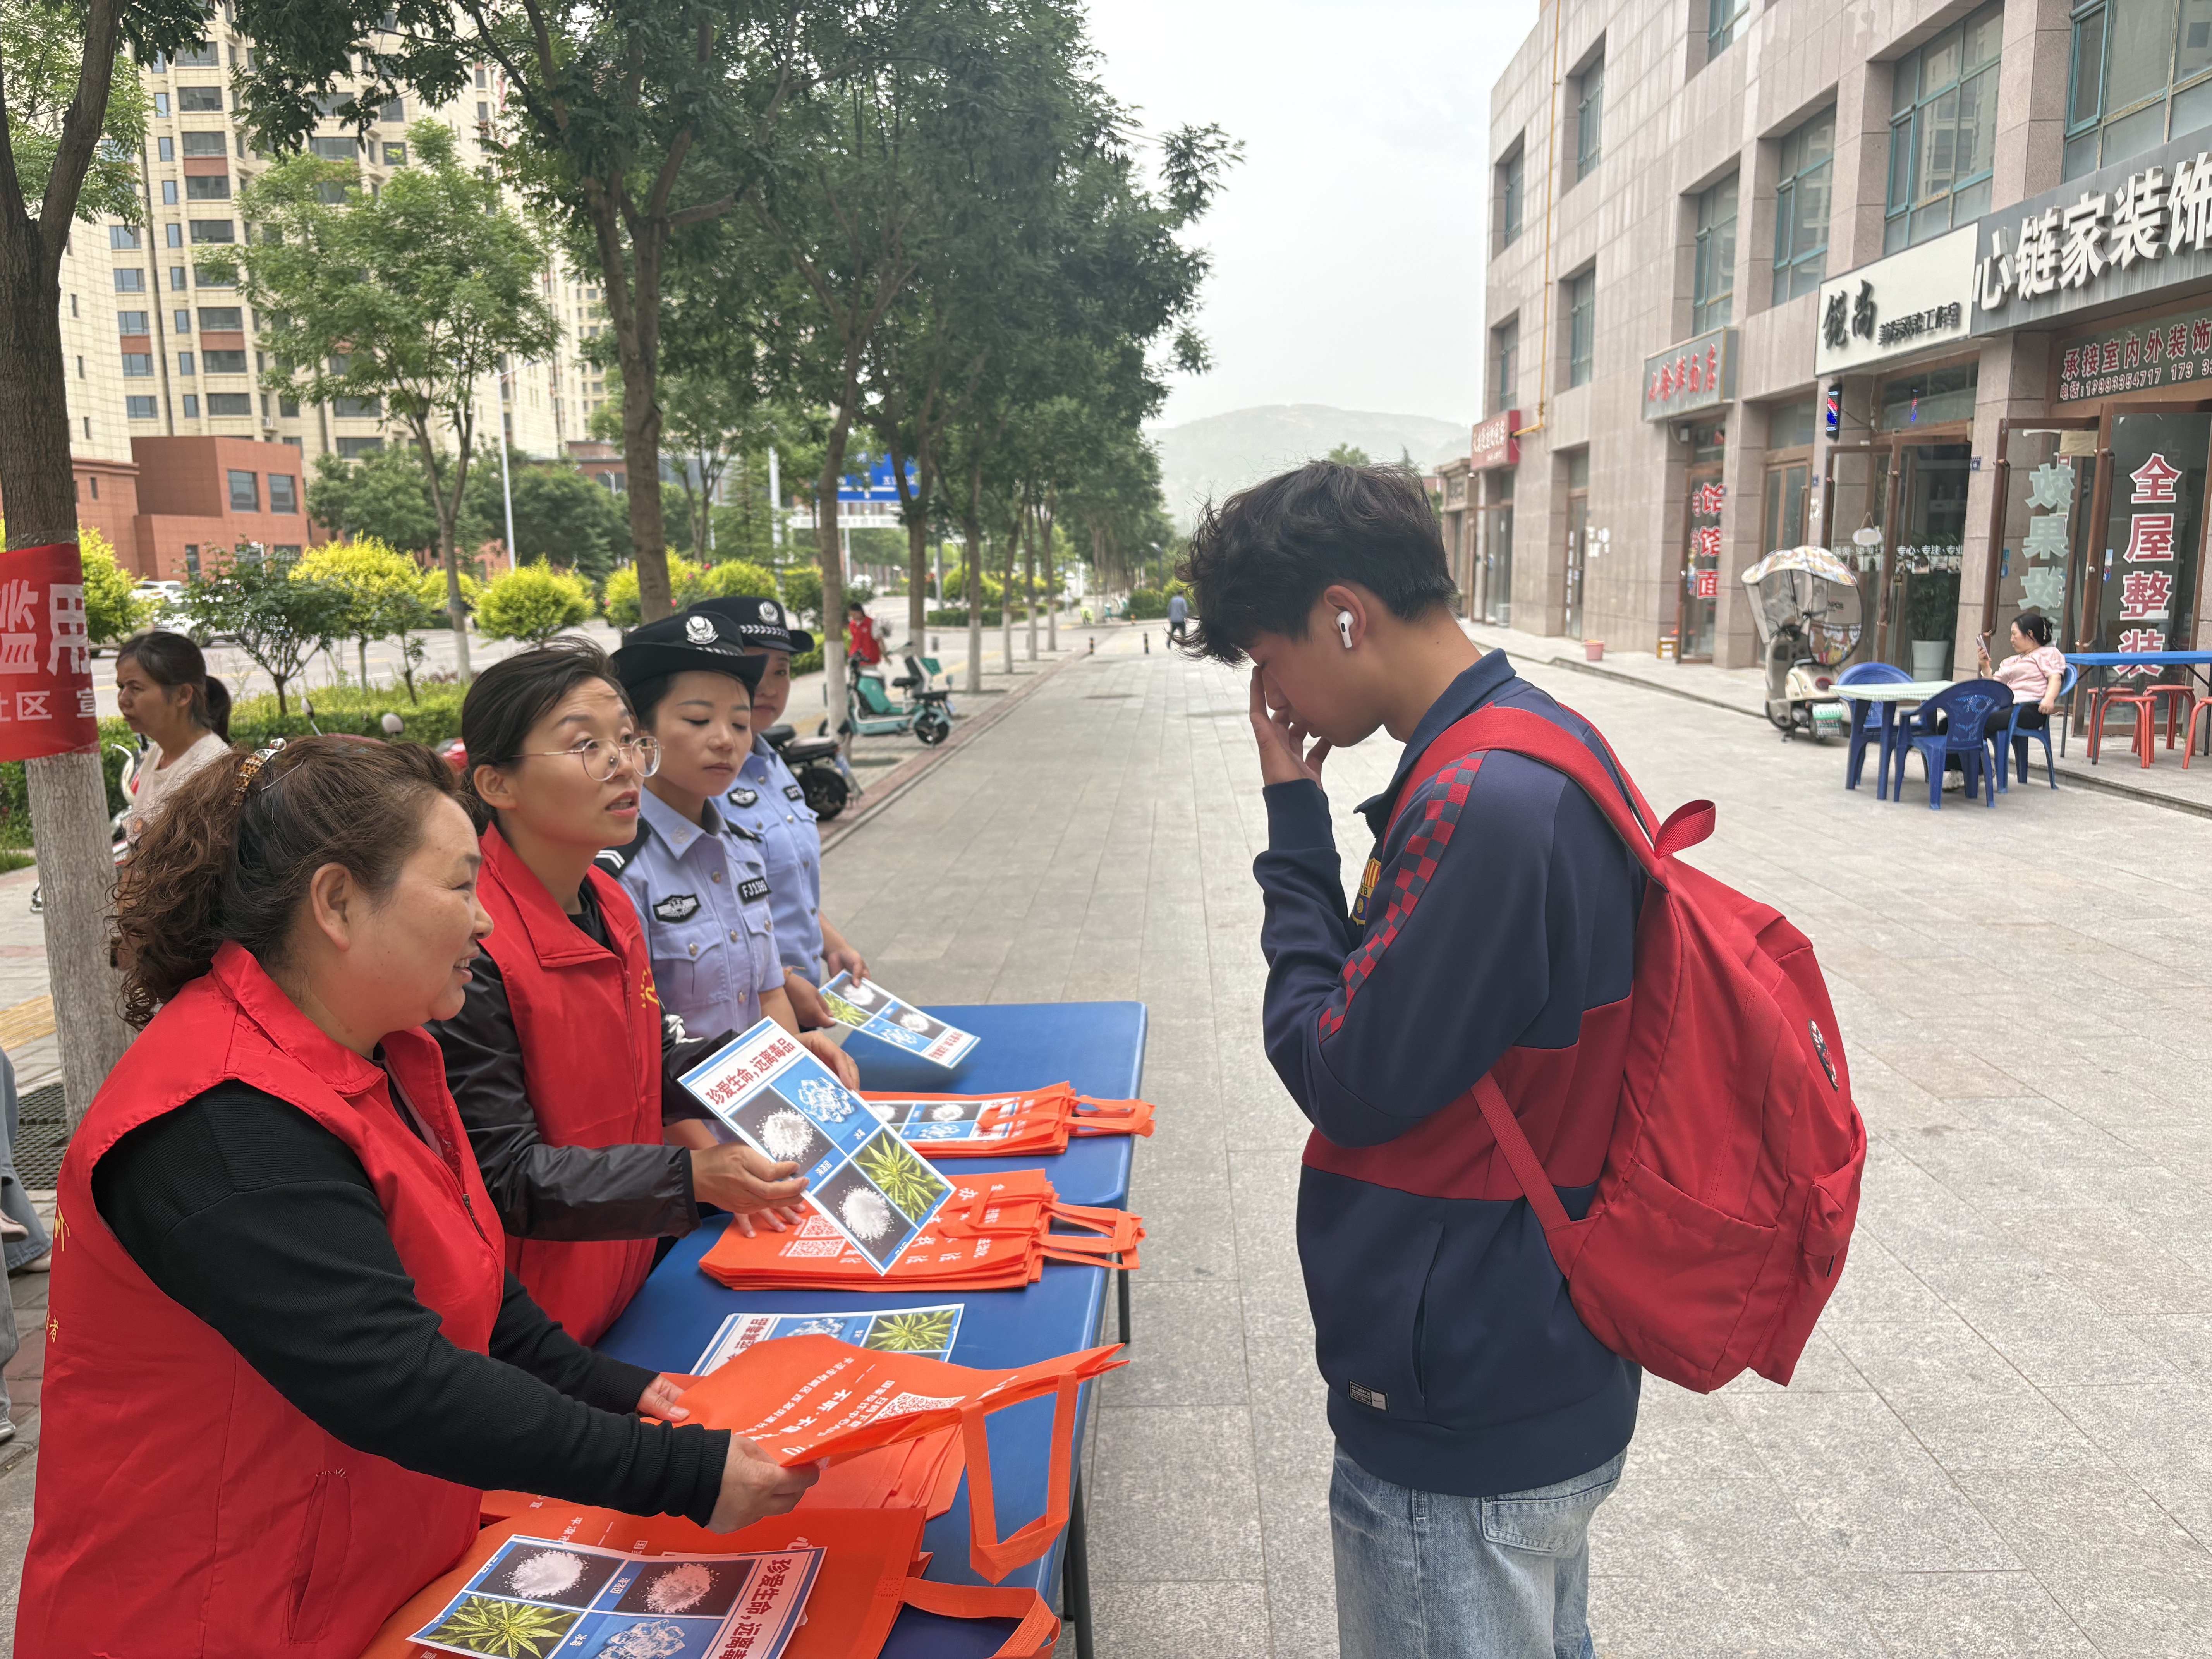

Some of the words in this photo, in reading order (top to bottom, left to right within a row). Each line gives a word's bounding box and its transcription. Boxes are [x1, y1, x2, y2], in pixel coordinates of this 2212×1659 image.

[1972, 151, 2212, 311] 心链家装饰
[2061, 318, 2212, 381] 承接室内外装饰
[2171, 361, 2193, 381] 173
[2113, 453, 2182, 678] 全屋整装
[727, 1318, 769, 1361] 远离毒品
[609, 1577, 631, 1594] 海洛因
